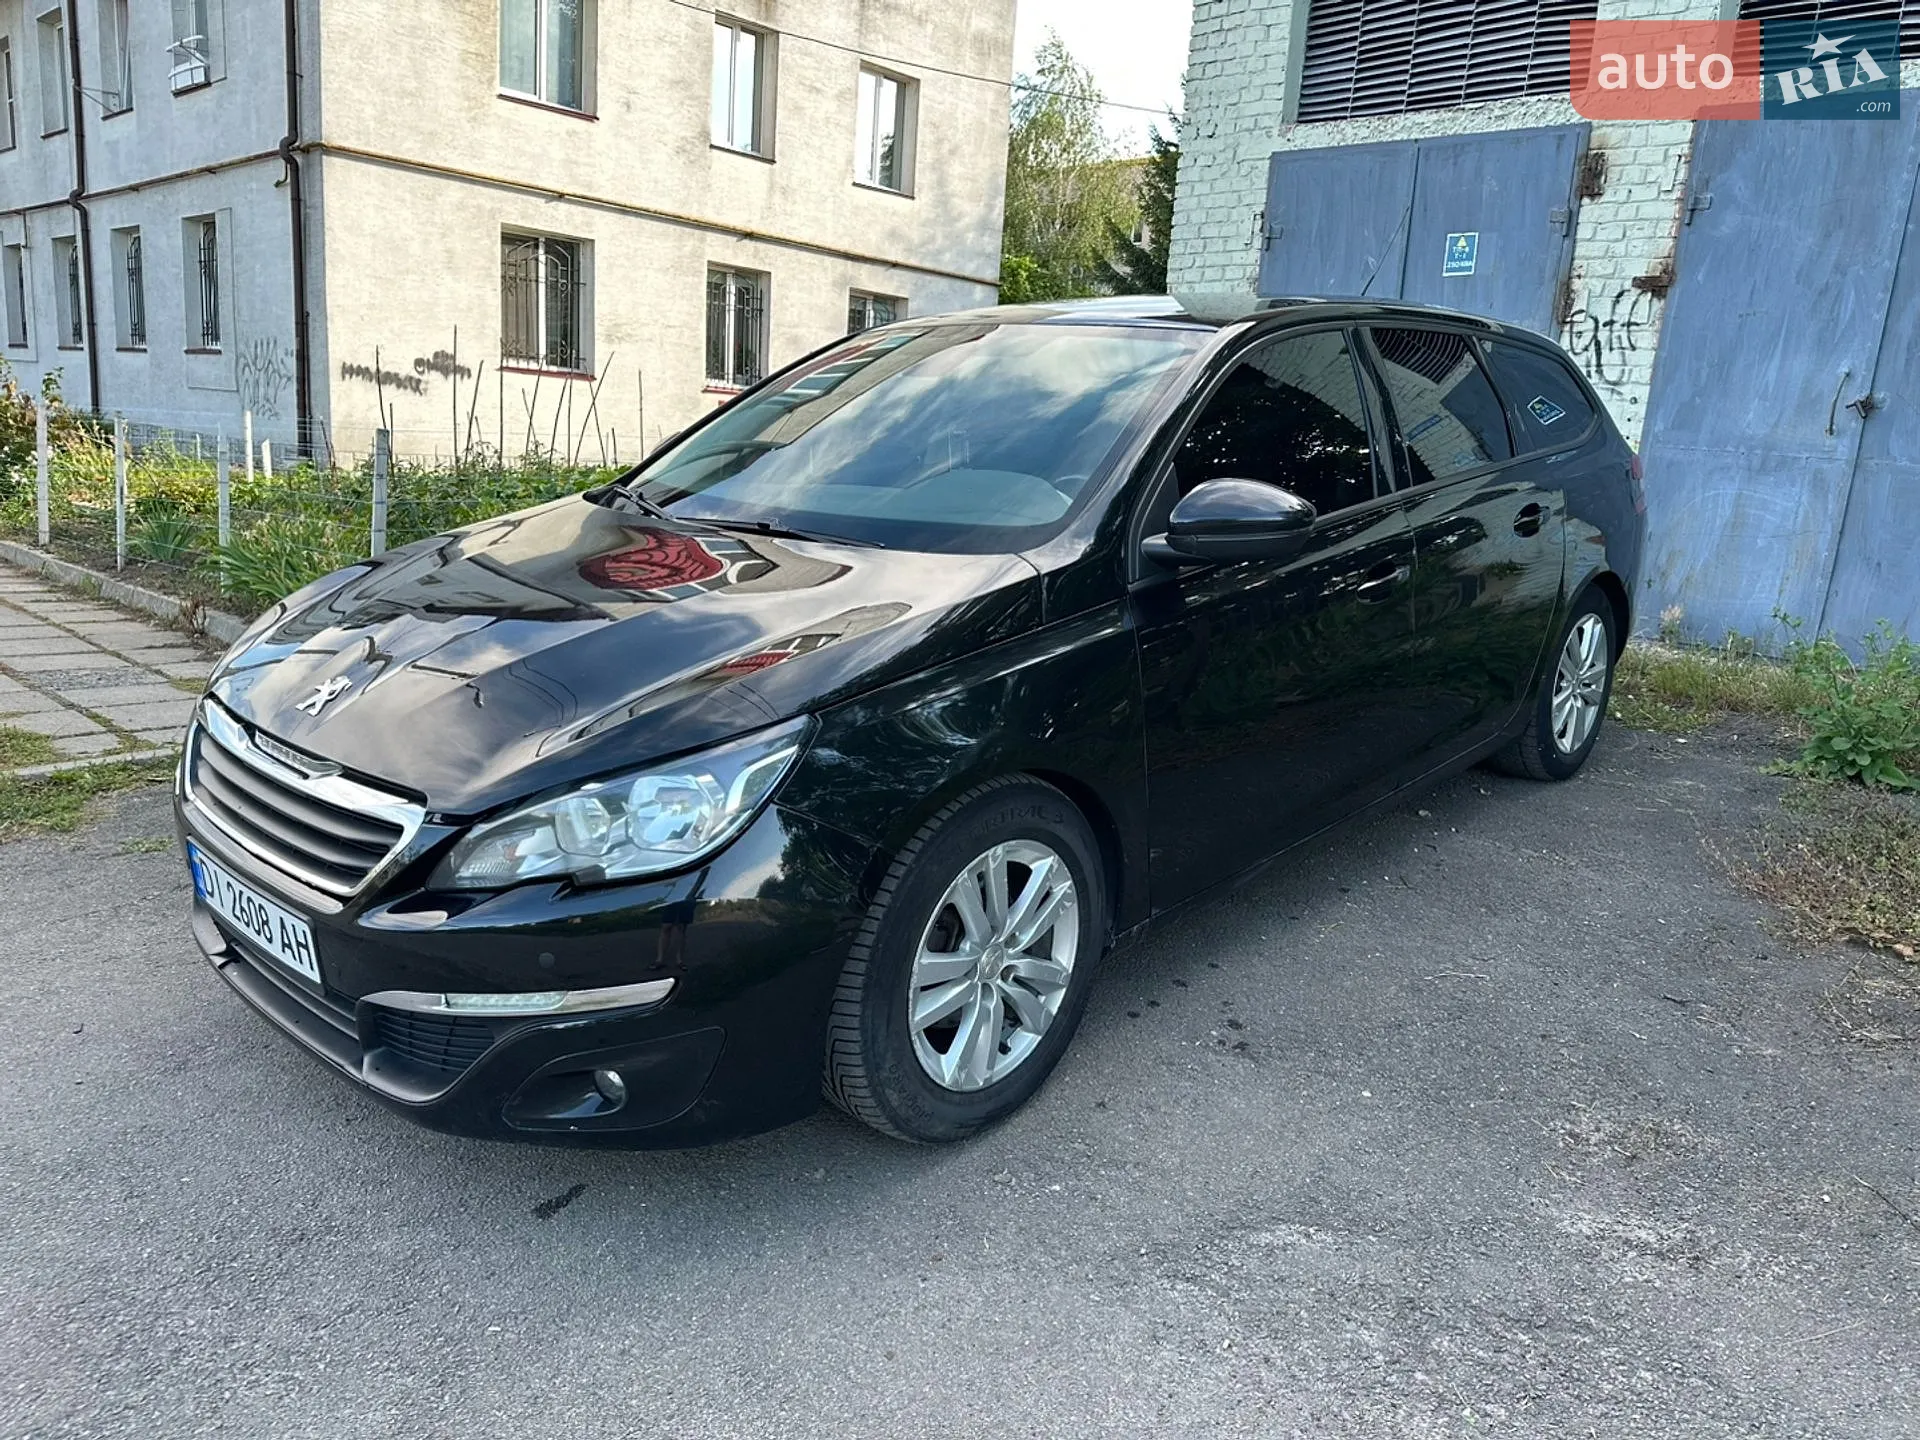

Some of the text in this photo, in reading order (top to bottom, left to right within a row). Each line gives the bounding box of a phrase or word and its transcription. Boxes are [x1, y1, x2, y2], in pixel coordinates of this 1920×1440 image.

[200, 857, 315, 972] DI 2608 AH
